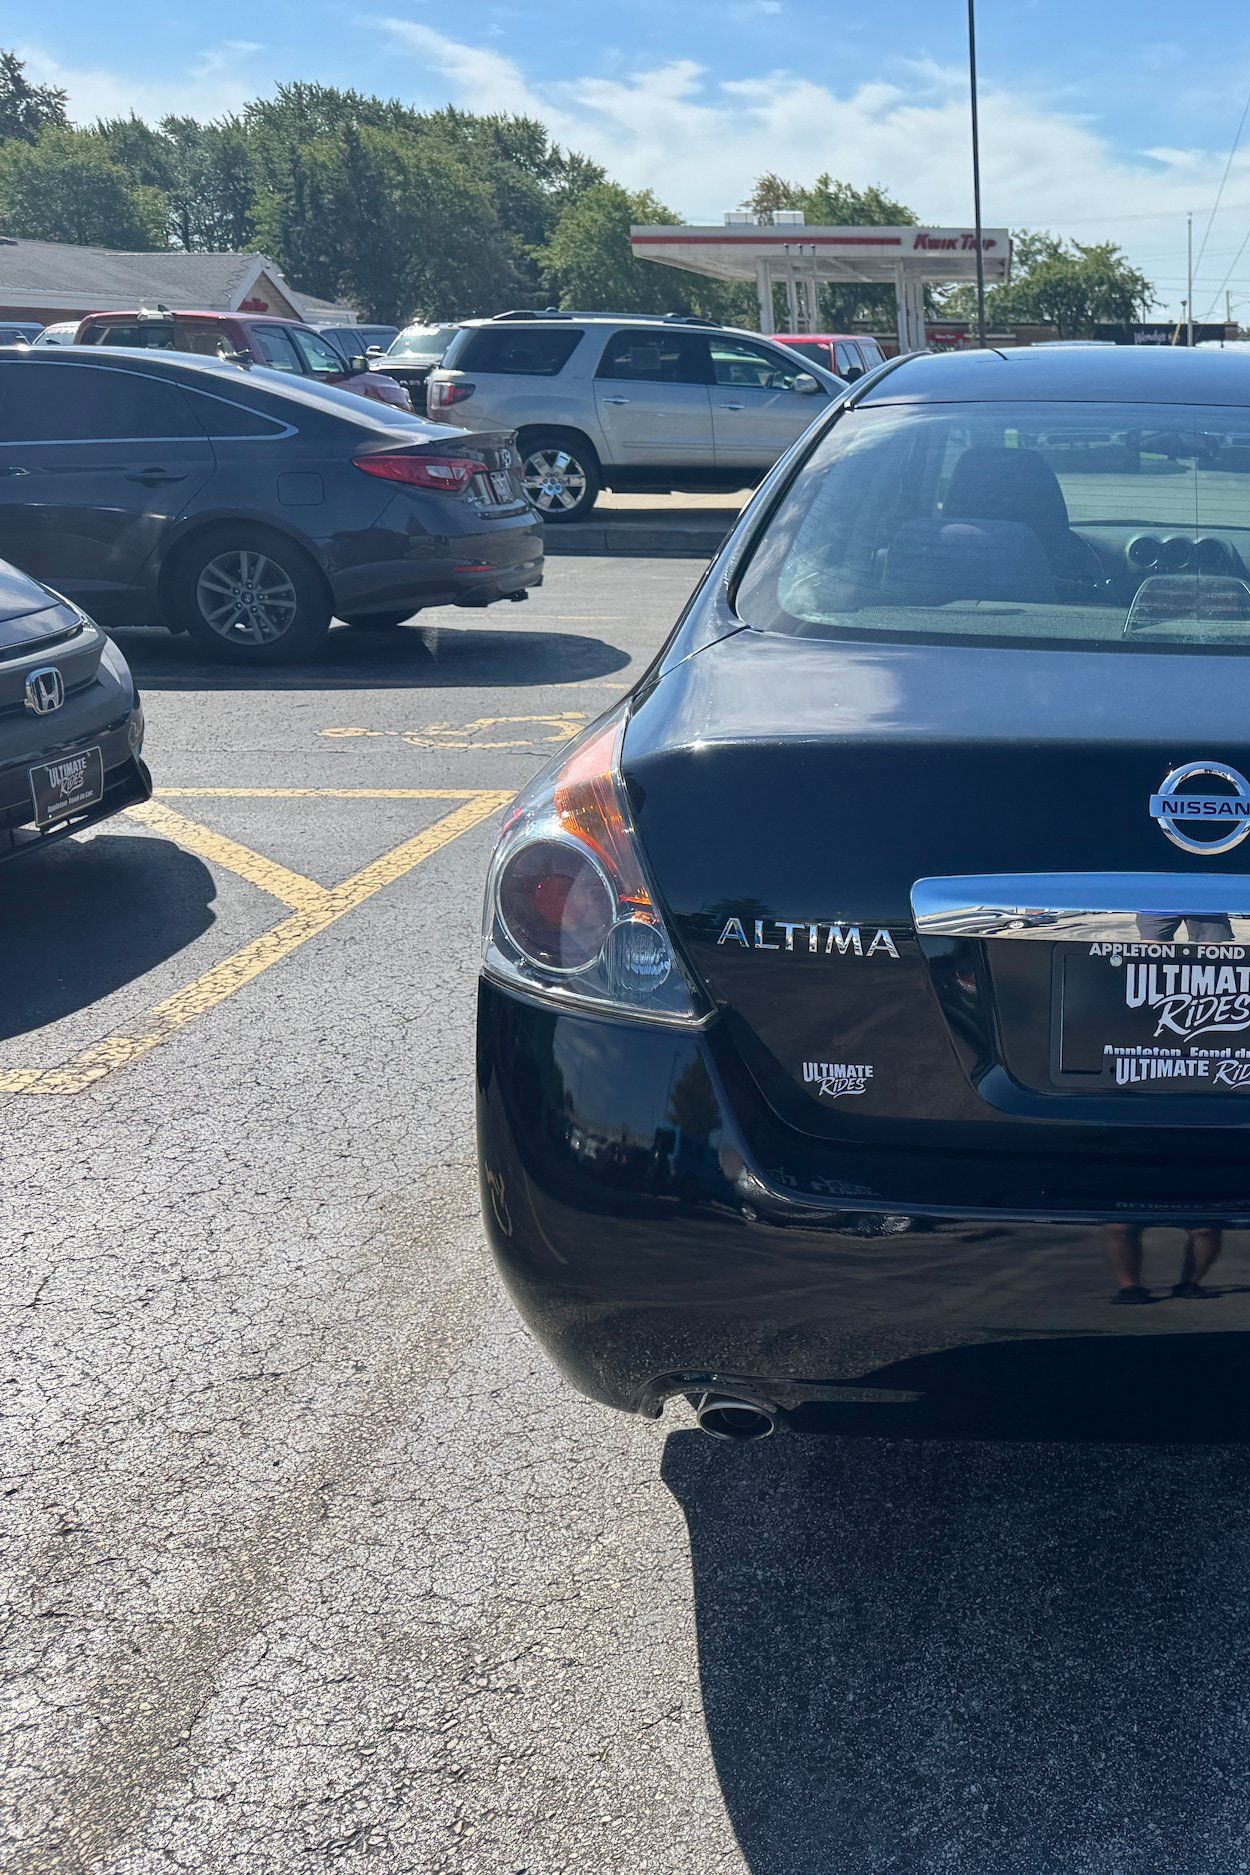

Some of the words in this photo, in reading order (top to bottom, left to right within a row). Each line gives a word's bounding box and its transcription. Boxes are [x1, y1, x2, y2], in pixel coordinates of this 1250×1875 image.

[913, 233, 958, 250] KWIK
[48, 757, 87, 788] ULTIMATE
[1162, 800, 1250, 815] NISSAN
[717, 917, 900, 959] ALTIMA
[1089, 943, 1176, 958] APPLETON
[1197, 945, 1246, 960] FOND
[802, 1062, 874, 1083] ULTIMATE
[1115, 1057, 1210, 1086] ULTIMATE
